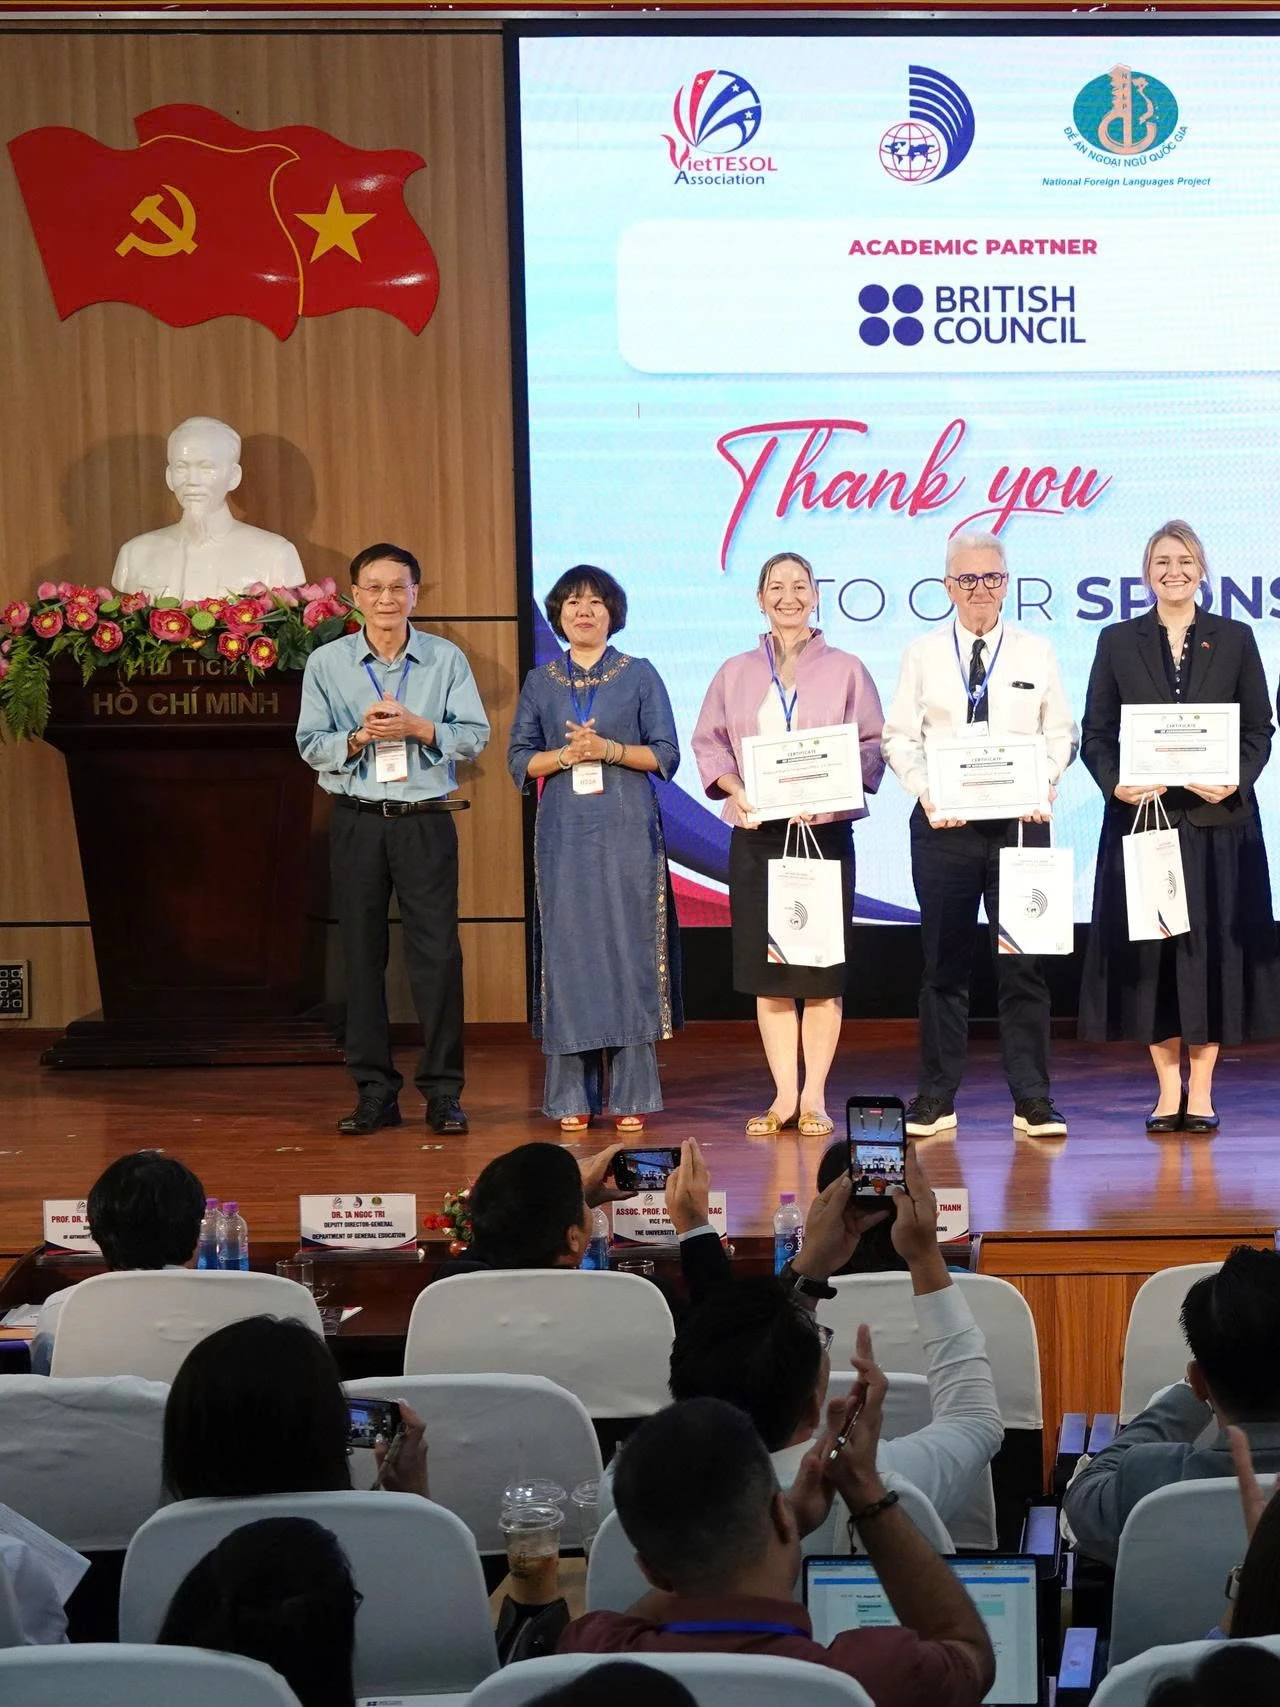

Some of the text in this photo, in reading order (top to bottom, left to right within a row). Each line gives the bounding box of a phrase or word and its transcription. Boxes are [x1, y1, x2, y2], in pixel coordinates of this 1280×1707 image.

[1174, 125, 1189, 143] GIA
[660, 134, 778, 171] VietTESOL
[674, 170, 765, 185] Association
[1042, 177, 1211, 188] National Foreign Languages Project
[848, 238, 1098, 256] ACADEMIC PARTNER
[935, 285, 1076, 313] BRITISH
[933, 316, 1087, 345] COUNCIL
[716, 418, 1113, 572] Thank you
[815, 577, 886, 622] TO
[908, 577, 1053, 622] OR
[93, 680, 279, 715] HỒ CHÍ MINH
[331, 1210, 386, 1219] DR. TA NGOC TRI
[616, 1208, 641, 1216] ASSOC.
[642, 1207, 661, 1216] PROF.
[939, 1204, 962, 1212] THANH
[51, 1215, 70, 1223] PROF.
[72, 1215, 83, 1223] DR.
